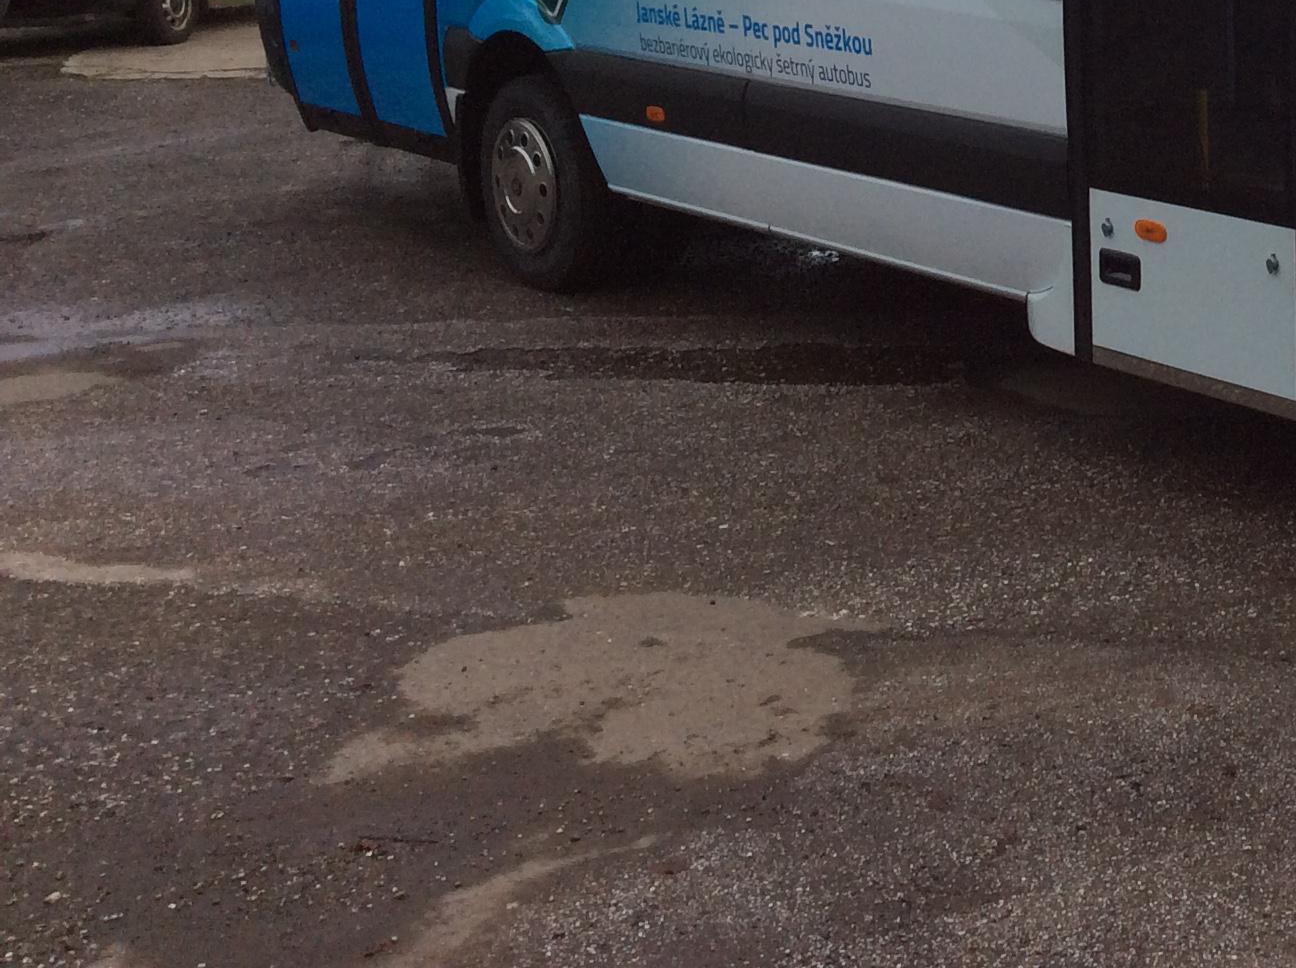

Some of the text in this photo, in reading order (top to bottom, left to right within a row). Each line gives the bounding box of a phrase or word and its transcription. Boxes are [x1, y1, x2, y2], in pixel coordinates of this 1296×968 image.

[636, 1, 681, 28] Janské
[684, 5, 725, 34] Lázně
[742, 14, 769, 40] Pec
[772, 21, 801, 48] pod
[804, 23, 873, 56] Sněžkou
[776, 53, 815, 85] šetrný
[818, 65, 872, 88] autobus
